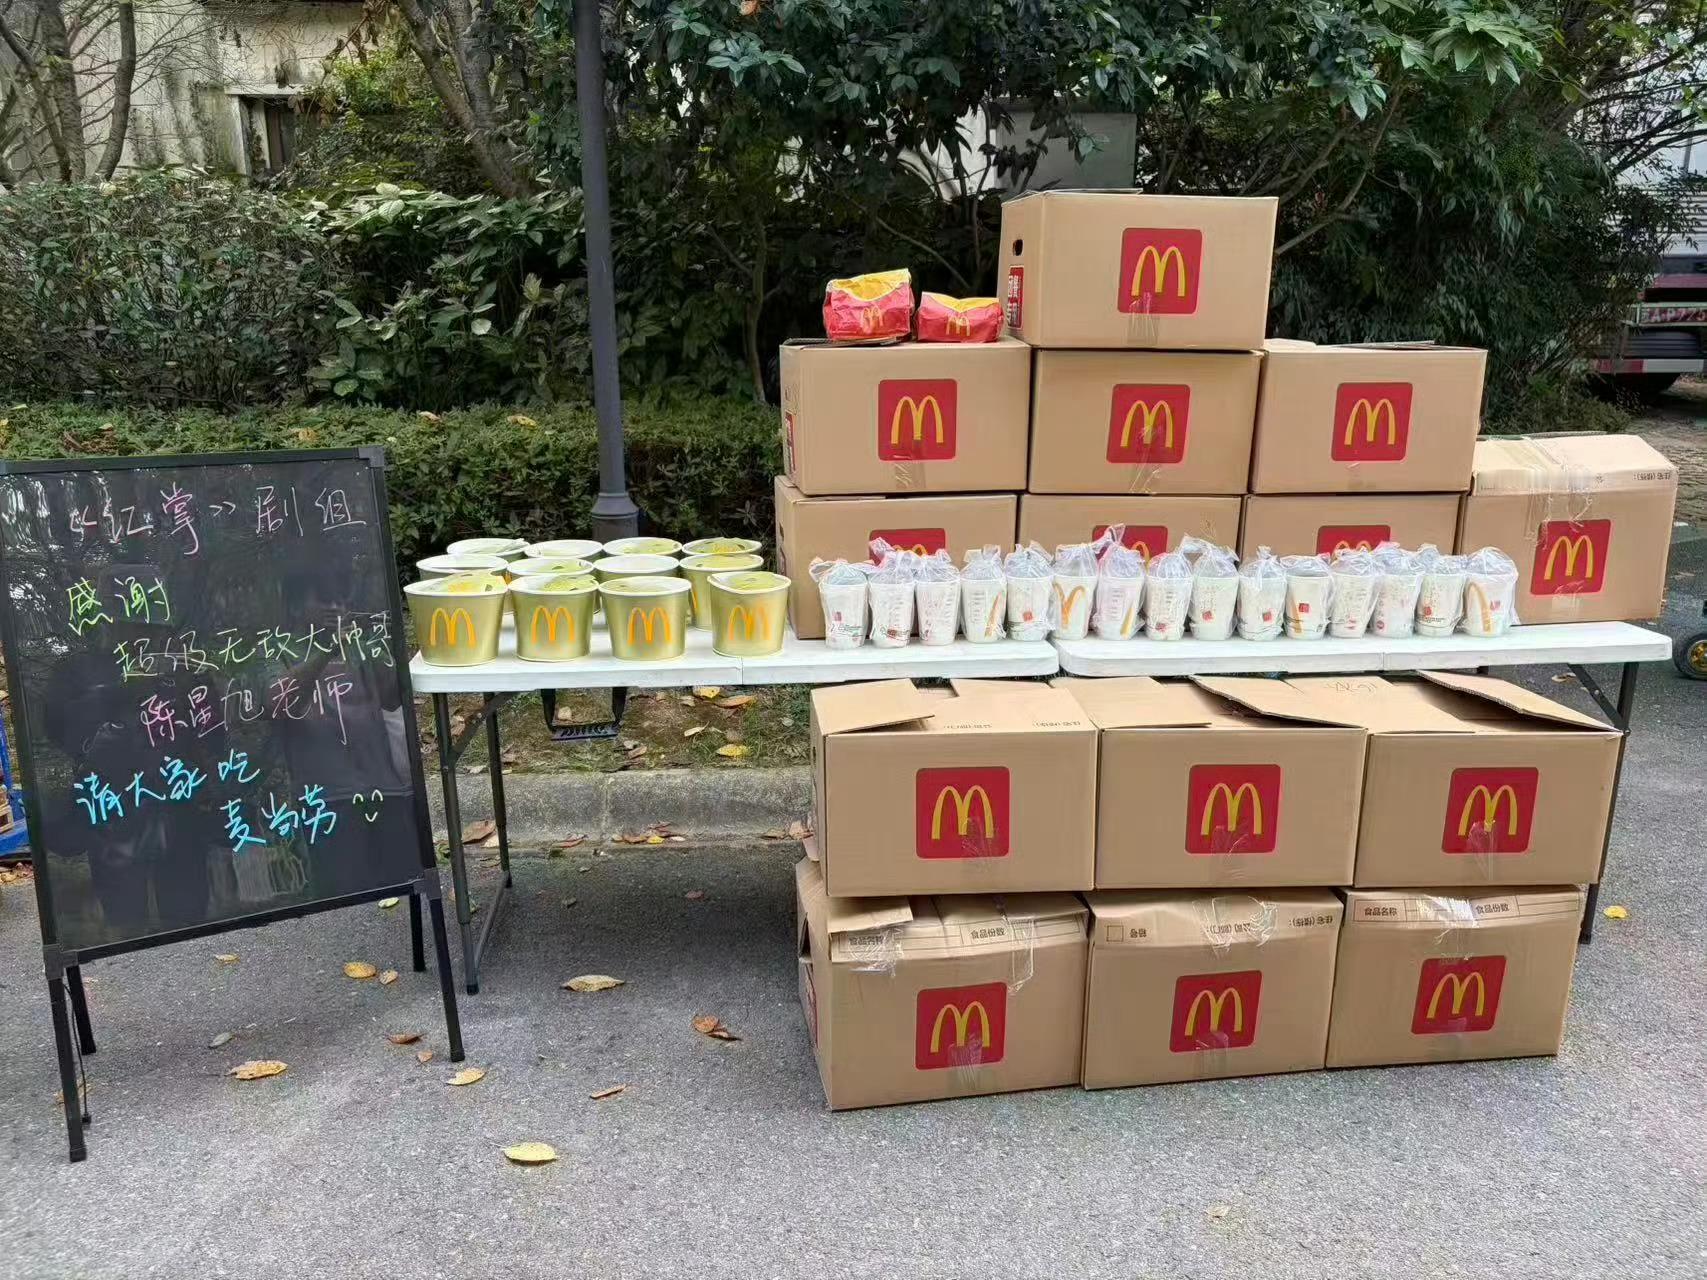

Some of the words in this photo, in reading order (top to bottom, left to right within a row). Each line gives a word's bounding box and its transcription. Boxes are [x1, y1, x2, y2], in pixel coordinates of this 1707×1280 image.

[66, 577, 170, 636] 感谢
[114, 610, 394, 682] 超级无敌大帅哥
[140, 672, 353, 747] 陈星旭老师
[74, 749, 260, 824] 请大家吃
[219, 784, 337, 851] 麦当劳
[970, 927, 1005, 940] 食品份数
[1364, 906, 1398, 917] 食品名称
[1476, 903, 1510, 914] 食品份数
